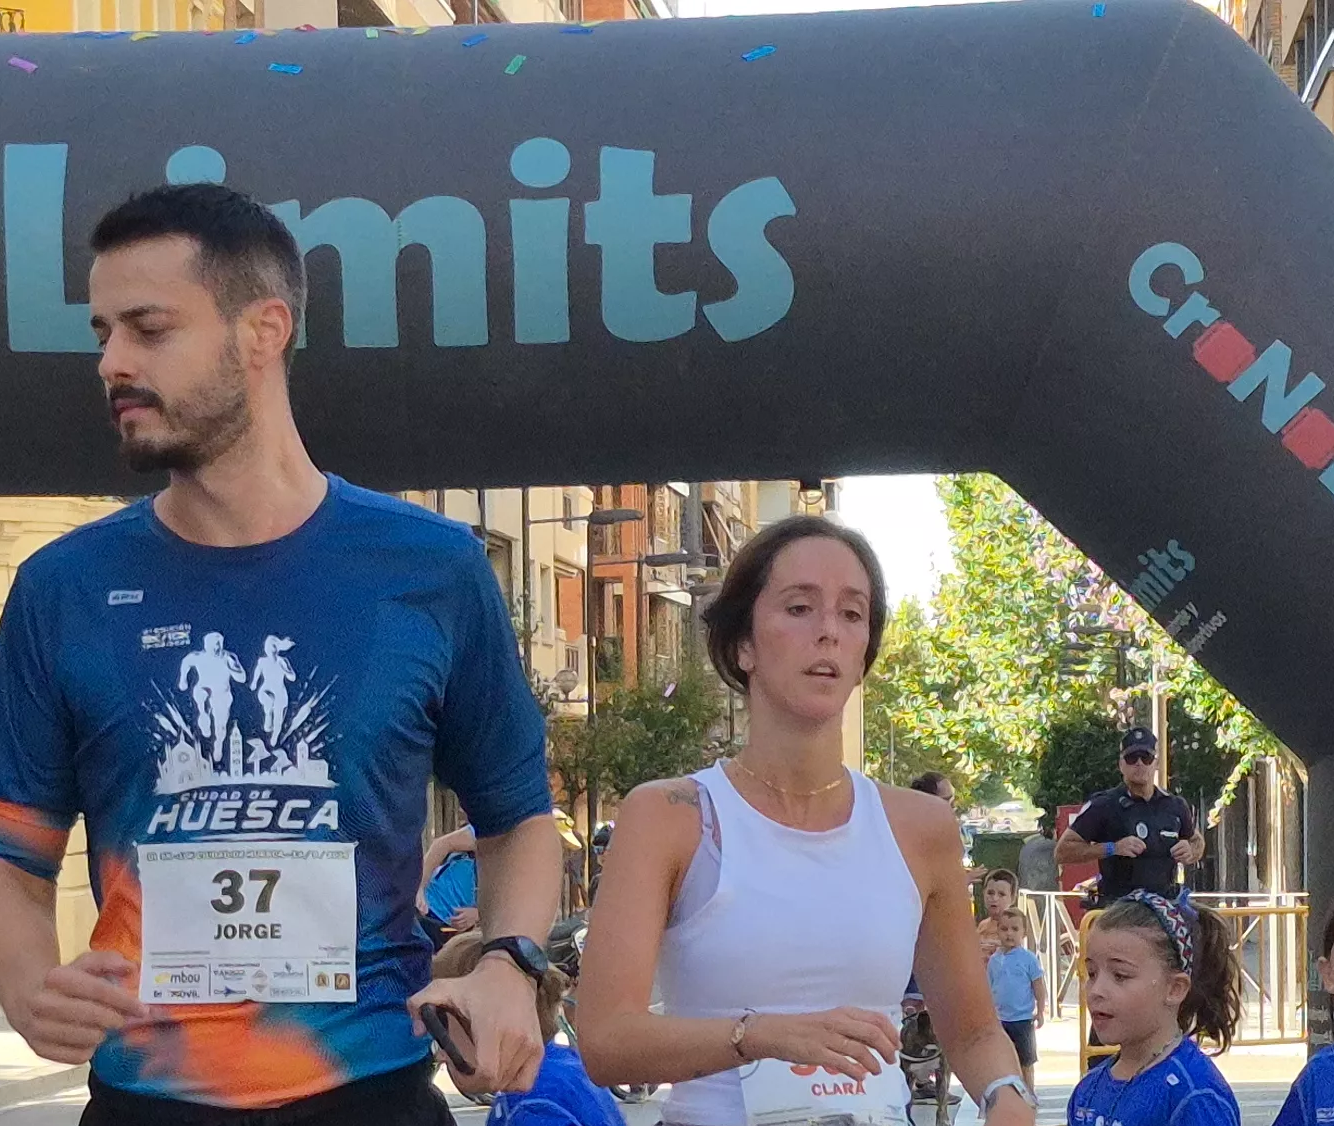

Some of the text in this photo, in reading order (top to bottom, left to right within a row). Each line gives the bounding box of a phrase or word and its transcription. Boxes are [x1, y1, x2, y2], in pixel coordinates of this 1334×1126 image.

[147, 799, 339, 835] HUESCA
[210, 869, 281, 914] 37
[214, 924, 282, 940] JORGE
[811, 1080, 866, 1097] CLARA
